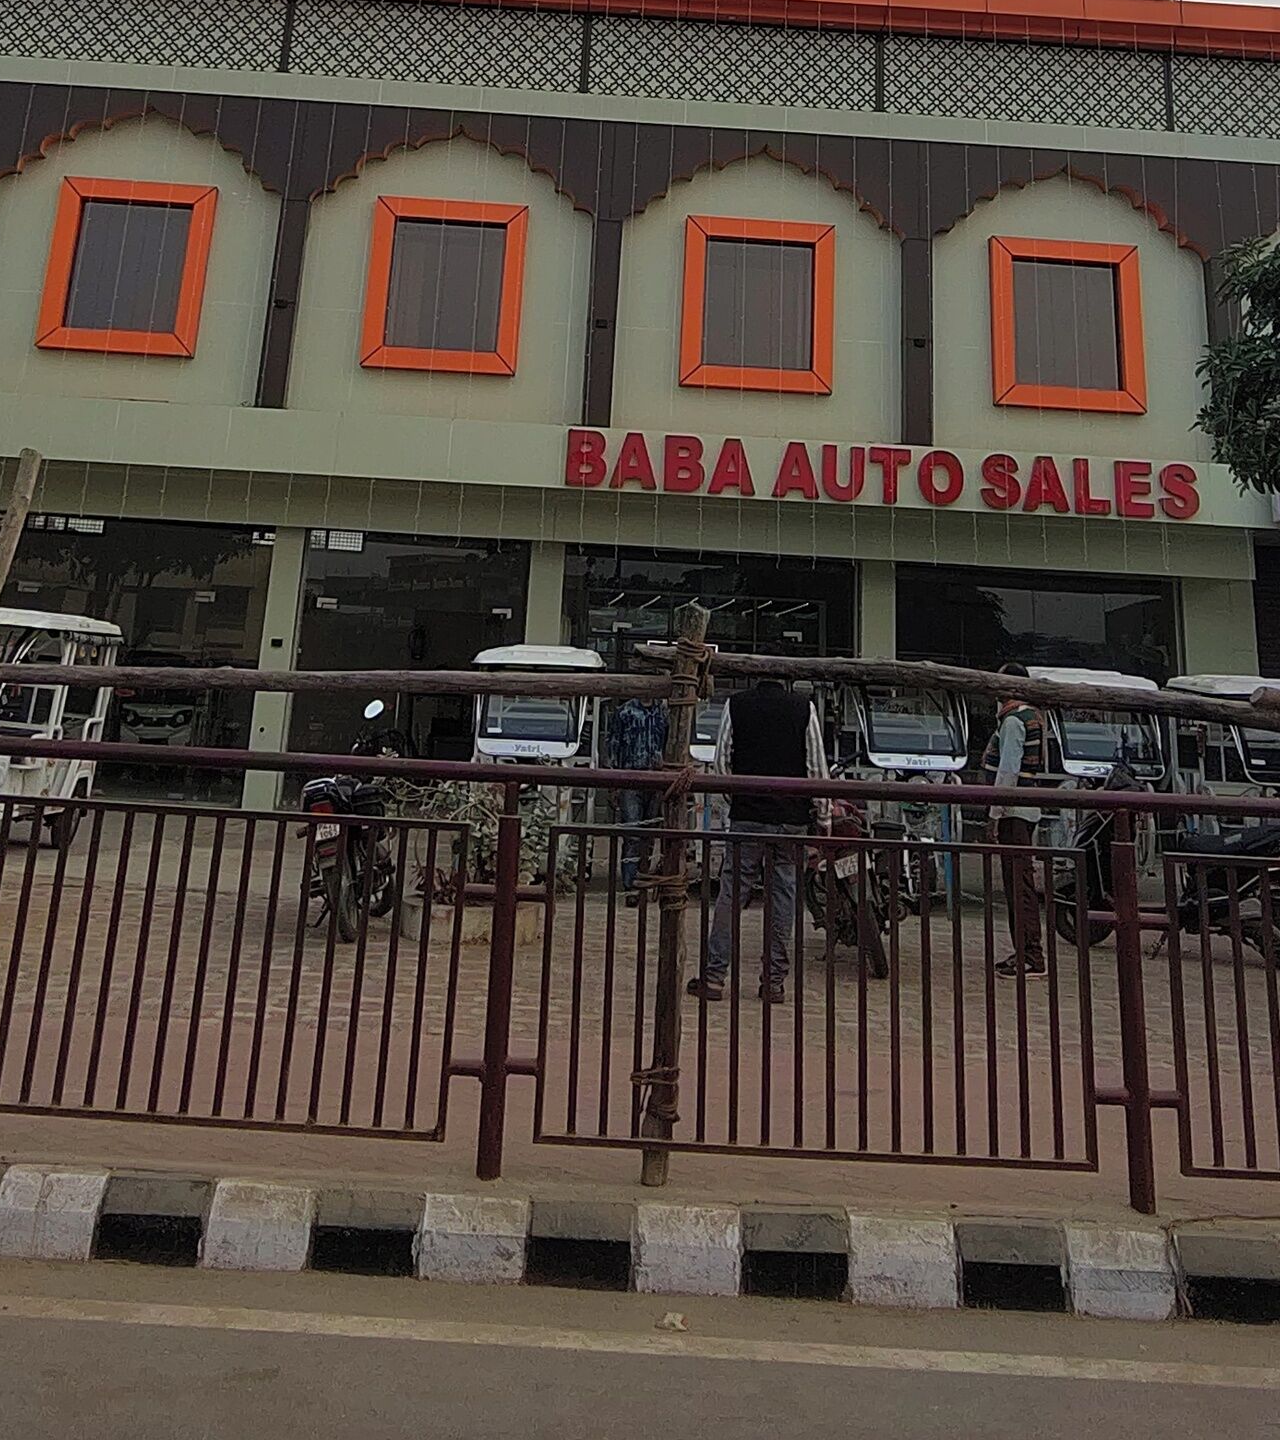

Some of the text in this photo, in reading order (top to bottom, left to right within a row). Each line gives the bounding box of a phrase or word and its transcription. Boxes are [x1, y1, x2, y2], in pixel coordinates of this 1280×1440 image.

[564, 428, 756, 498] BABA
[771, 440, 965, 506] AUTO
[979, 452, 1201, 520] SALES
